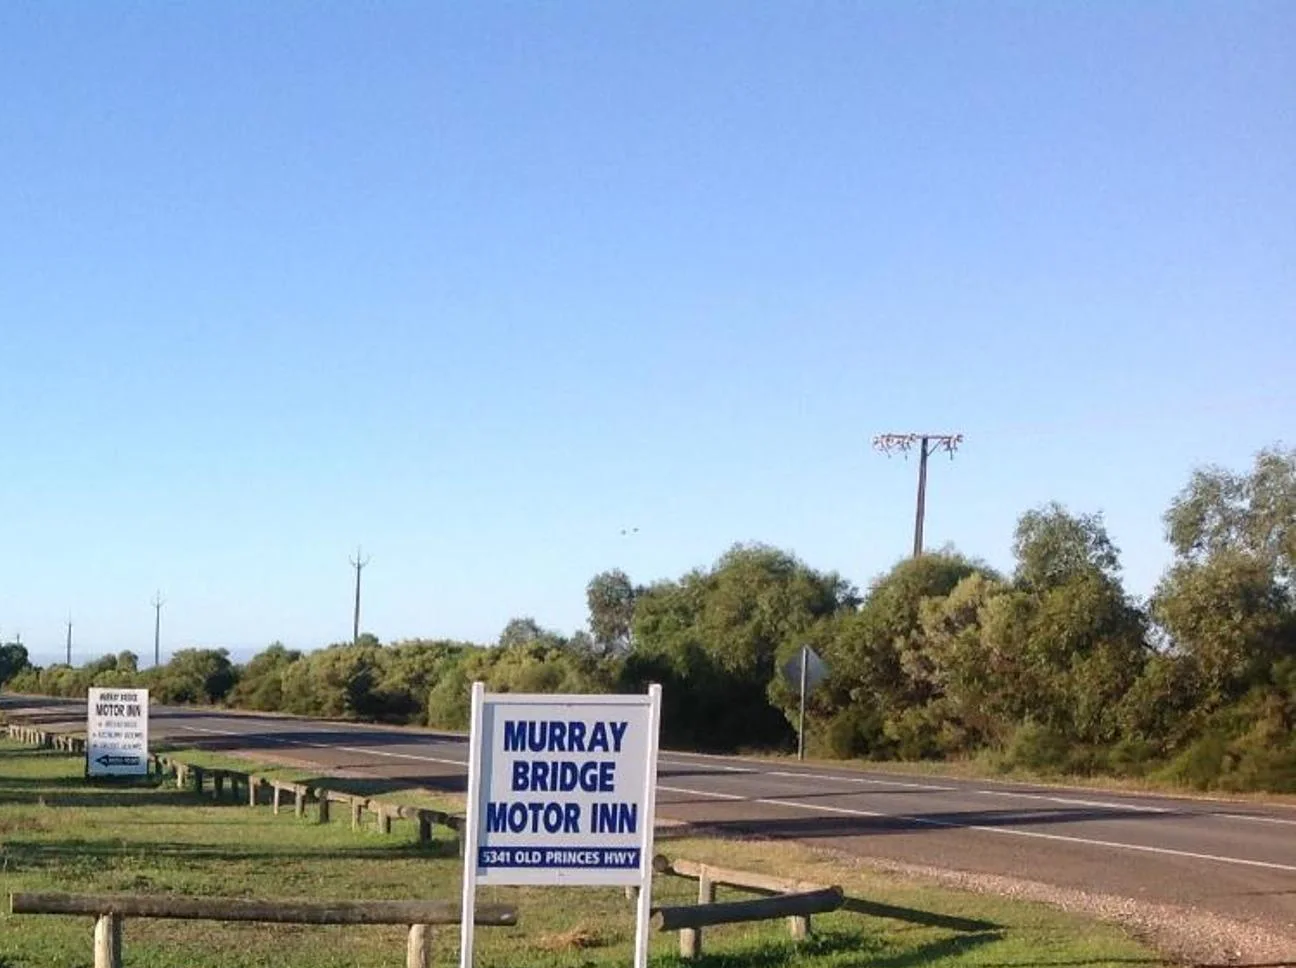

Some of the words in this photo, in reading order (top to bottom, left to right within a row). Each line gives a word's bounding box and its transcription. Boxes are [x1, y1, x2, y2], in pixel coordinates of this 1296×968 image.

[96, 703, 125, 716] MOTOR
[126, 704, 141, 717] INN
[504, 720, 628, 752] MURRAY
[512, 761, 616, 792] BRIDGE
[486, 803, 581, 833] MOTOR
[590, 803, 638, 834] INN
[482, 850, 511, 864] 5341
[515, 851, 542, 864] OLD
[545, 851, 600, 865] PRINCES
[604, 851, 636, 865] HWY
